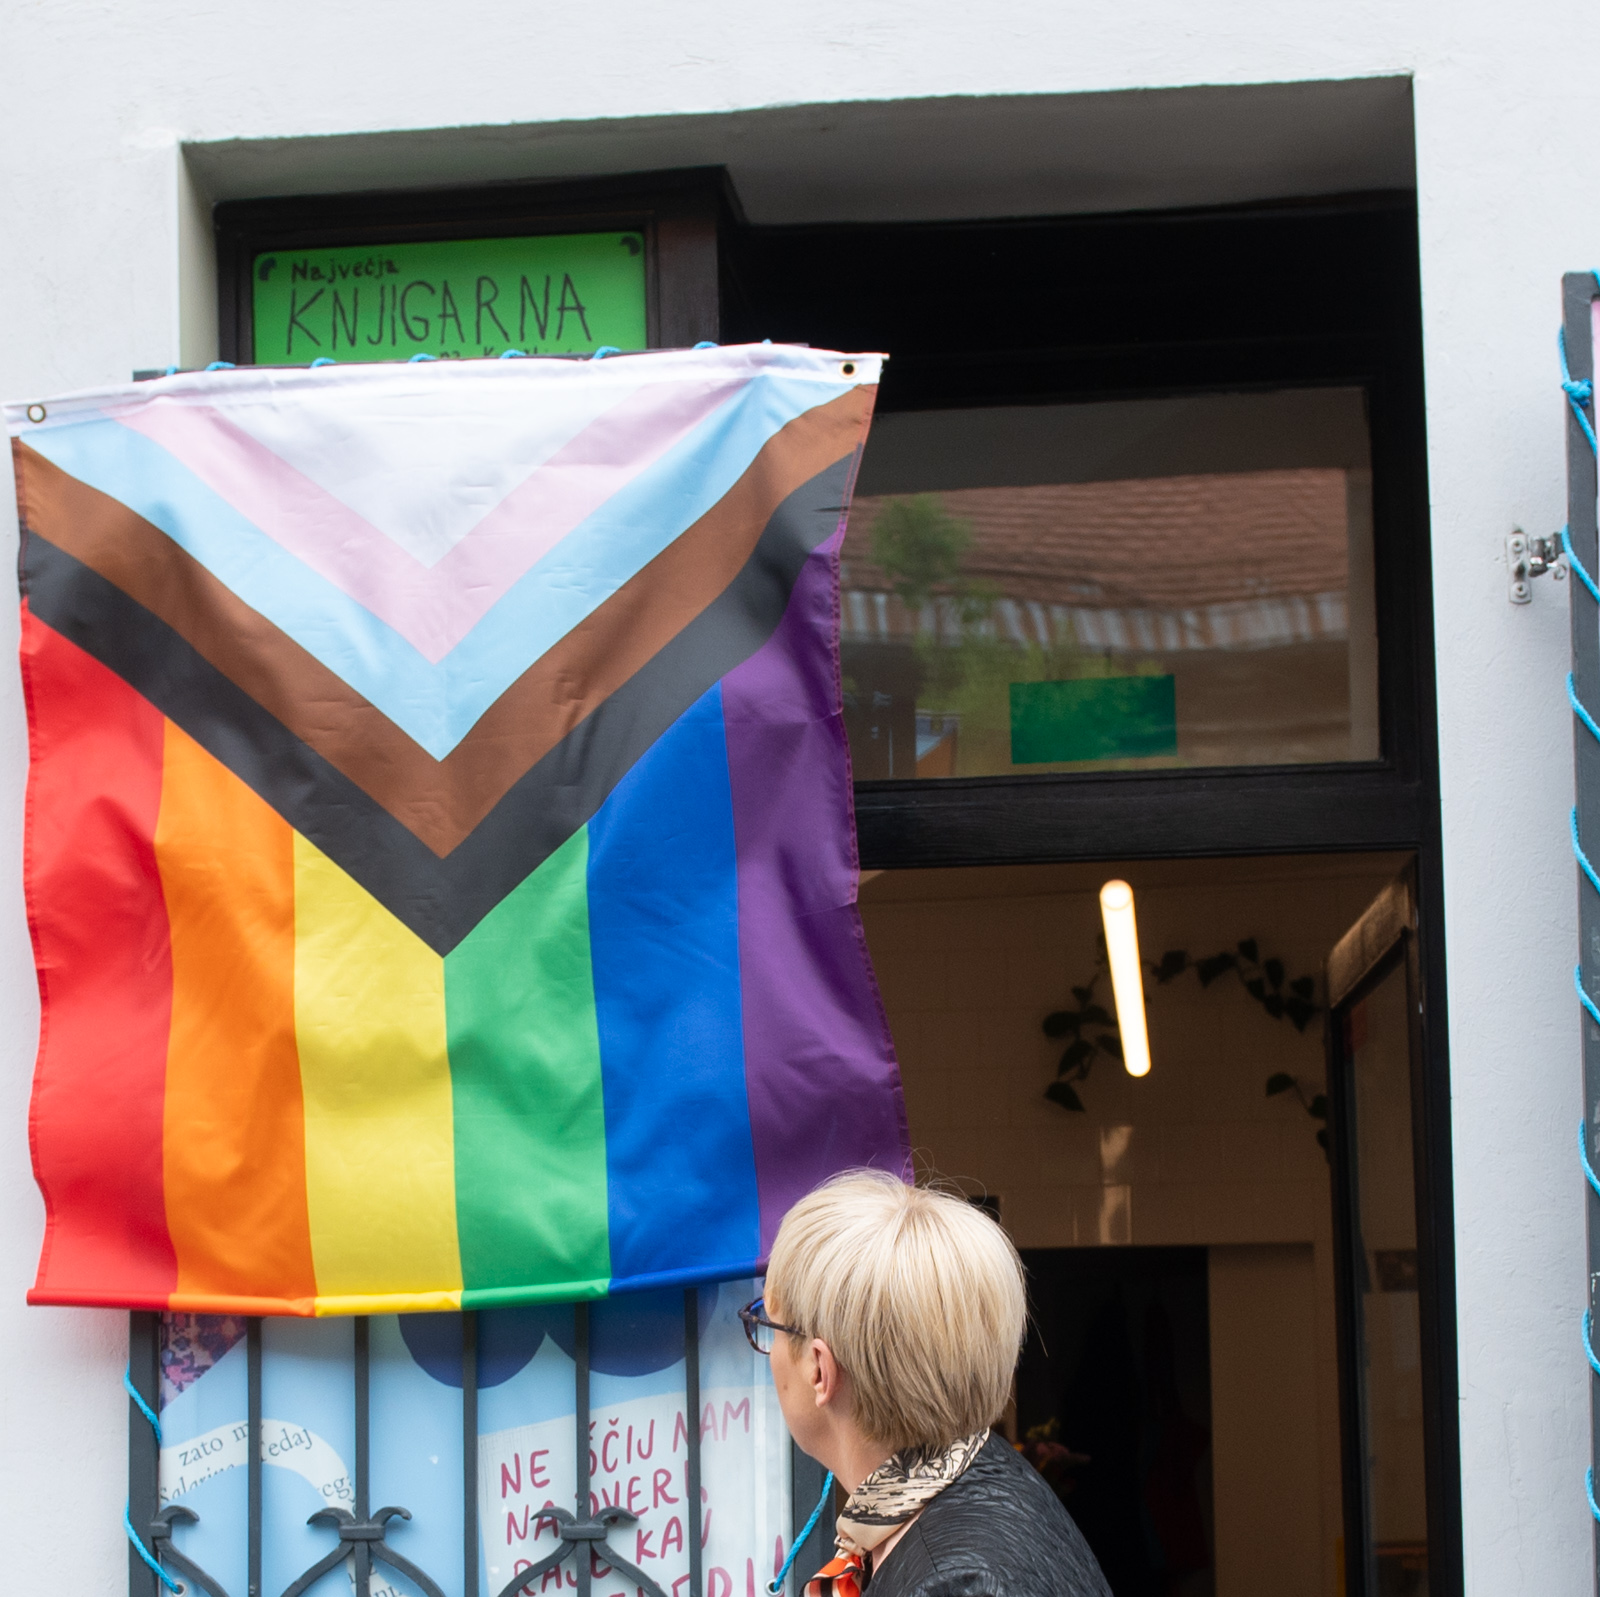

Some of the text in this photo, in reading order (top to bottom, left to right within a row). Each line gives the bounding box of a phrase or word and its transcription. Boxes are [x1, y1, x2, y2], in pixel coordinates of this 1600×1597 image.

[290, 254, 400, 284] Največja
[286, 273, 593, 356] KNJIGARNA
[178, 1436, 224, 1468] zato
[501, 1448, 551, 1499] NE
[672, 1396, 751, 1453] NAM
[506, 1499, 559, 1545] NA
